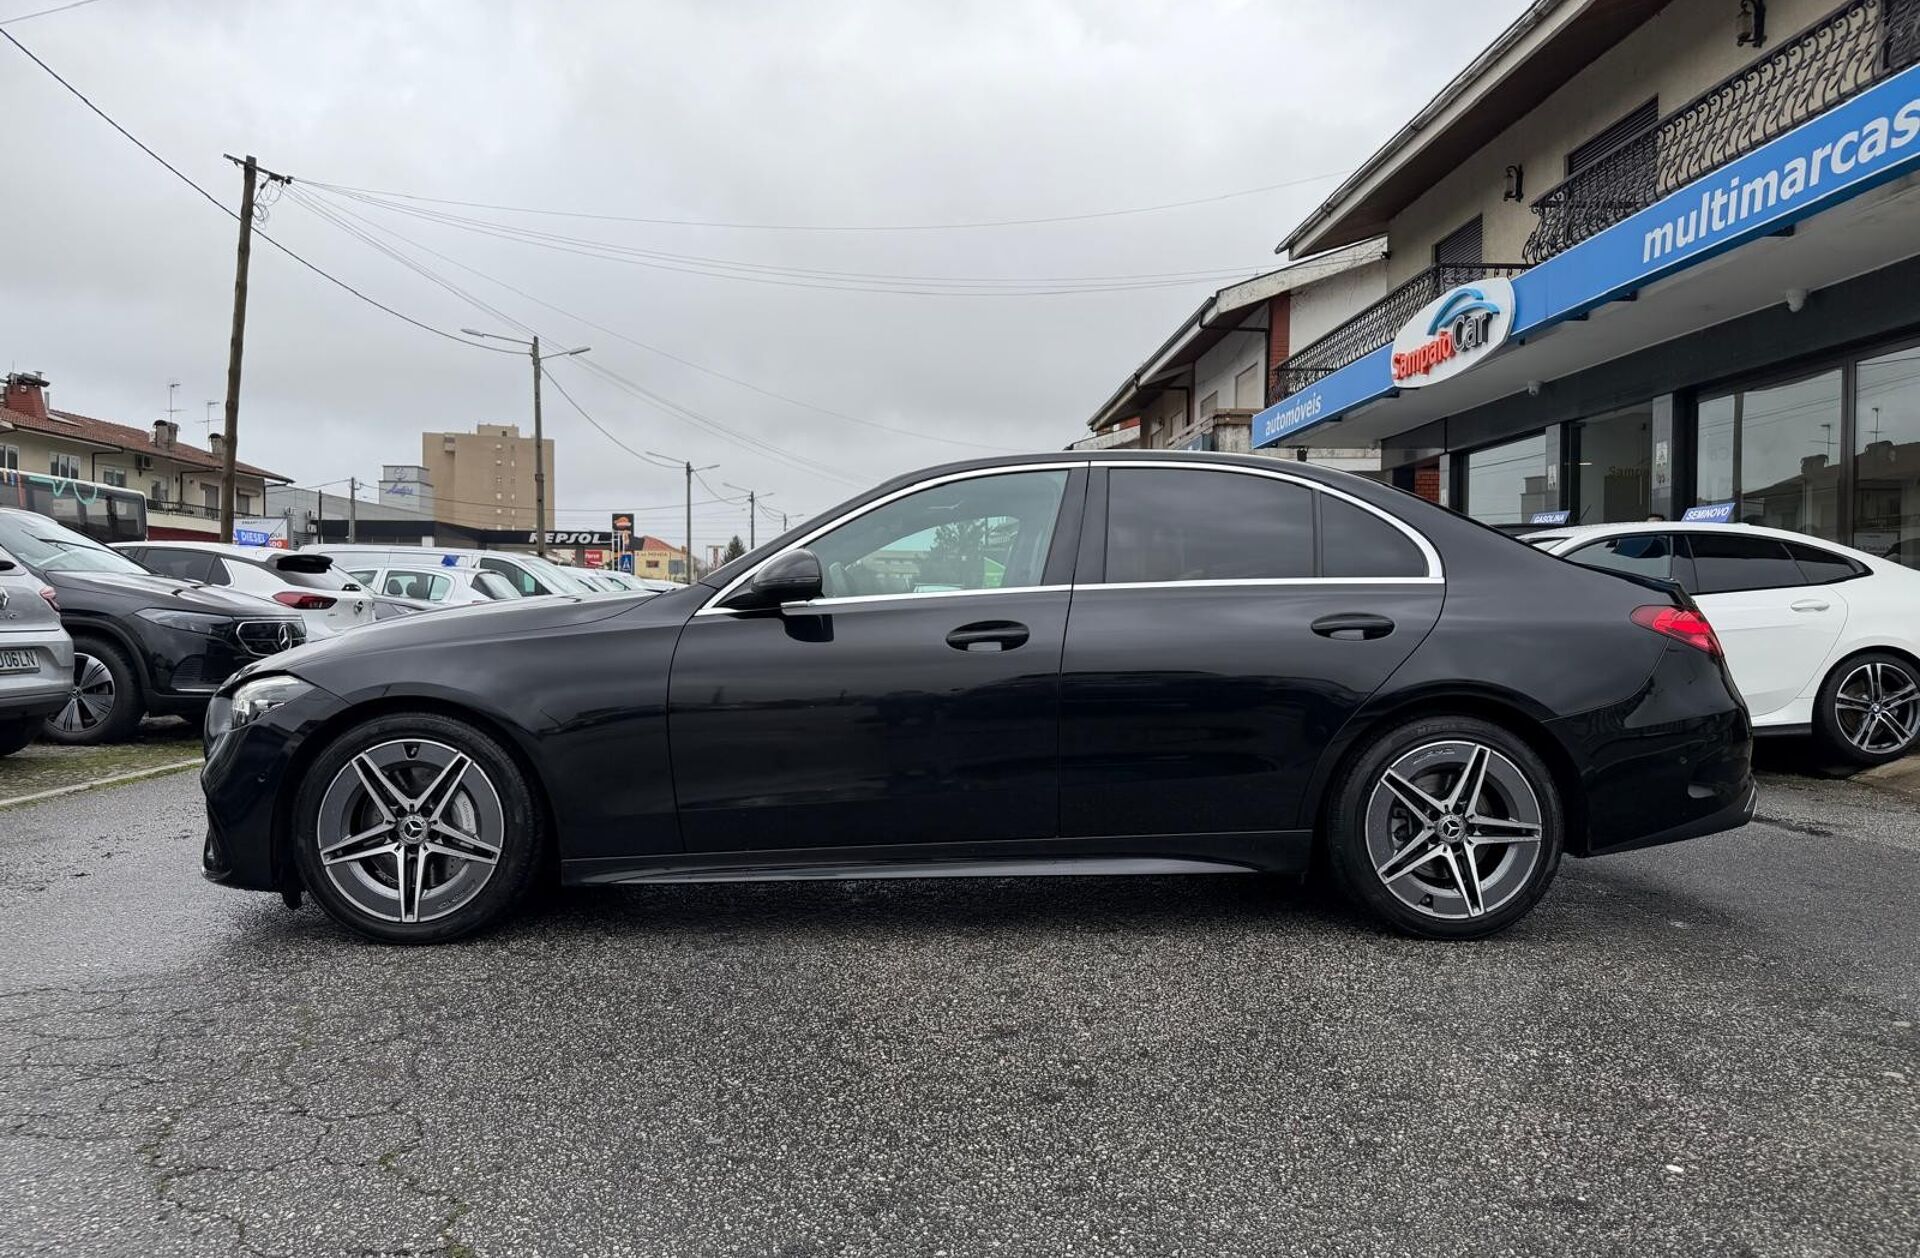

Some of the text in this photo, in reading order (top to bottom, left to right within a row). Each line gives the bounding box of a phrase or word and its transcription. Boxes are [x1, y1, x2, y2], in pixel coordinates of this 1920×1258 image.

[1642, 100, 1920, 263] multimarcas
[1265, 393, 1321, 437] automóveis
[1534, 513, 1566, 523] GASOLINA
[1686, 507, 1730, 521] SEMINOVO
[240, 532, 267, 543] DIESEL
